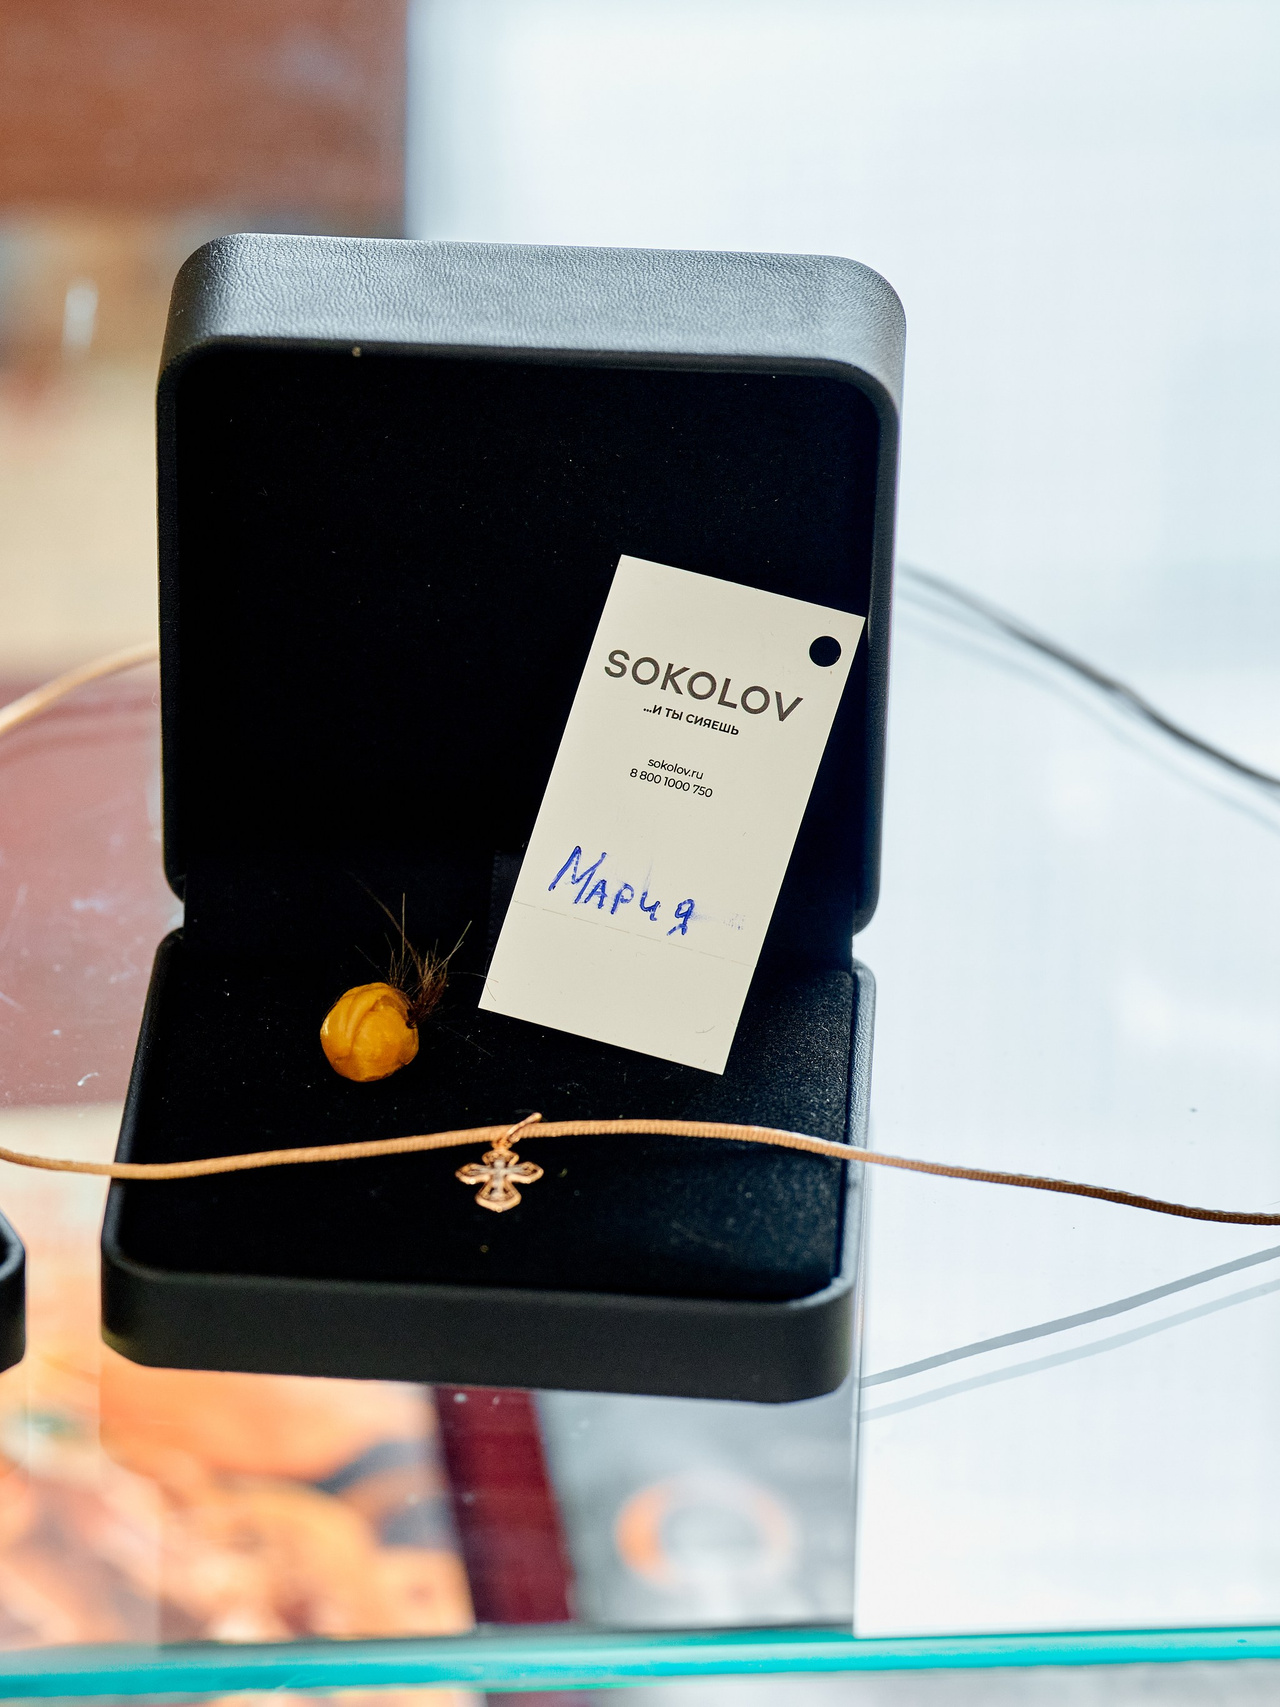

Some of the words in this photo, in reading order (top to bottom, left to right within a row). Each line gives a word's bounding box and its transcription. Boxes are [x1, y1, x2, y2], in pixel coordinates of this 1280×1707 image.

[604, 649, 804, 722] SOKOLOV
[665, 707, 684, 721] ТЫ
[685, 713, 739, 736] СИЯЕШЬ
[629, 767, 638, 778] 8
[639, 770, 662, 785] 800
[663, 776, 691, 792] 1000
[692, 783, 713, 798] 750
[647, 757, 704, 780] sokolov.ru
